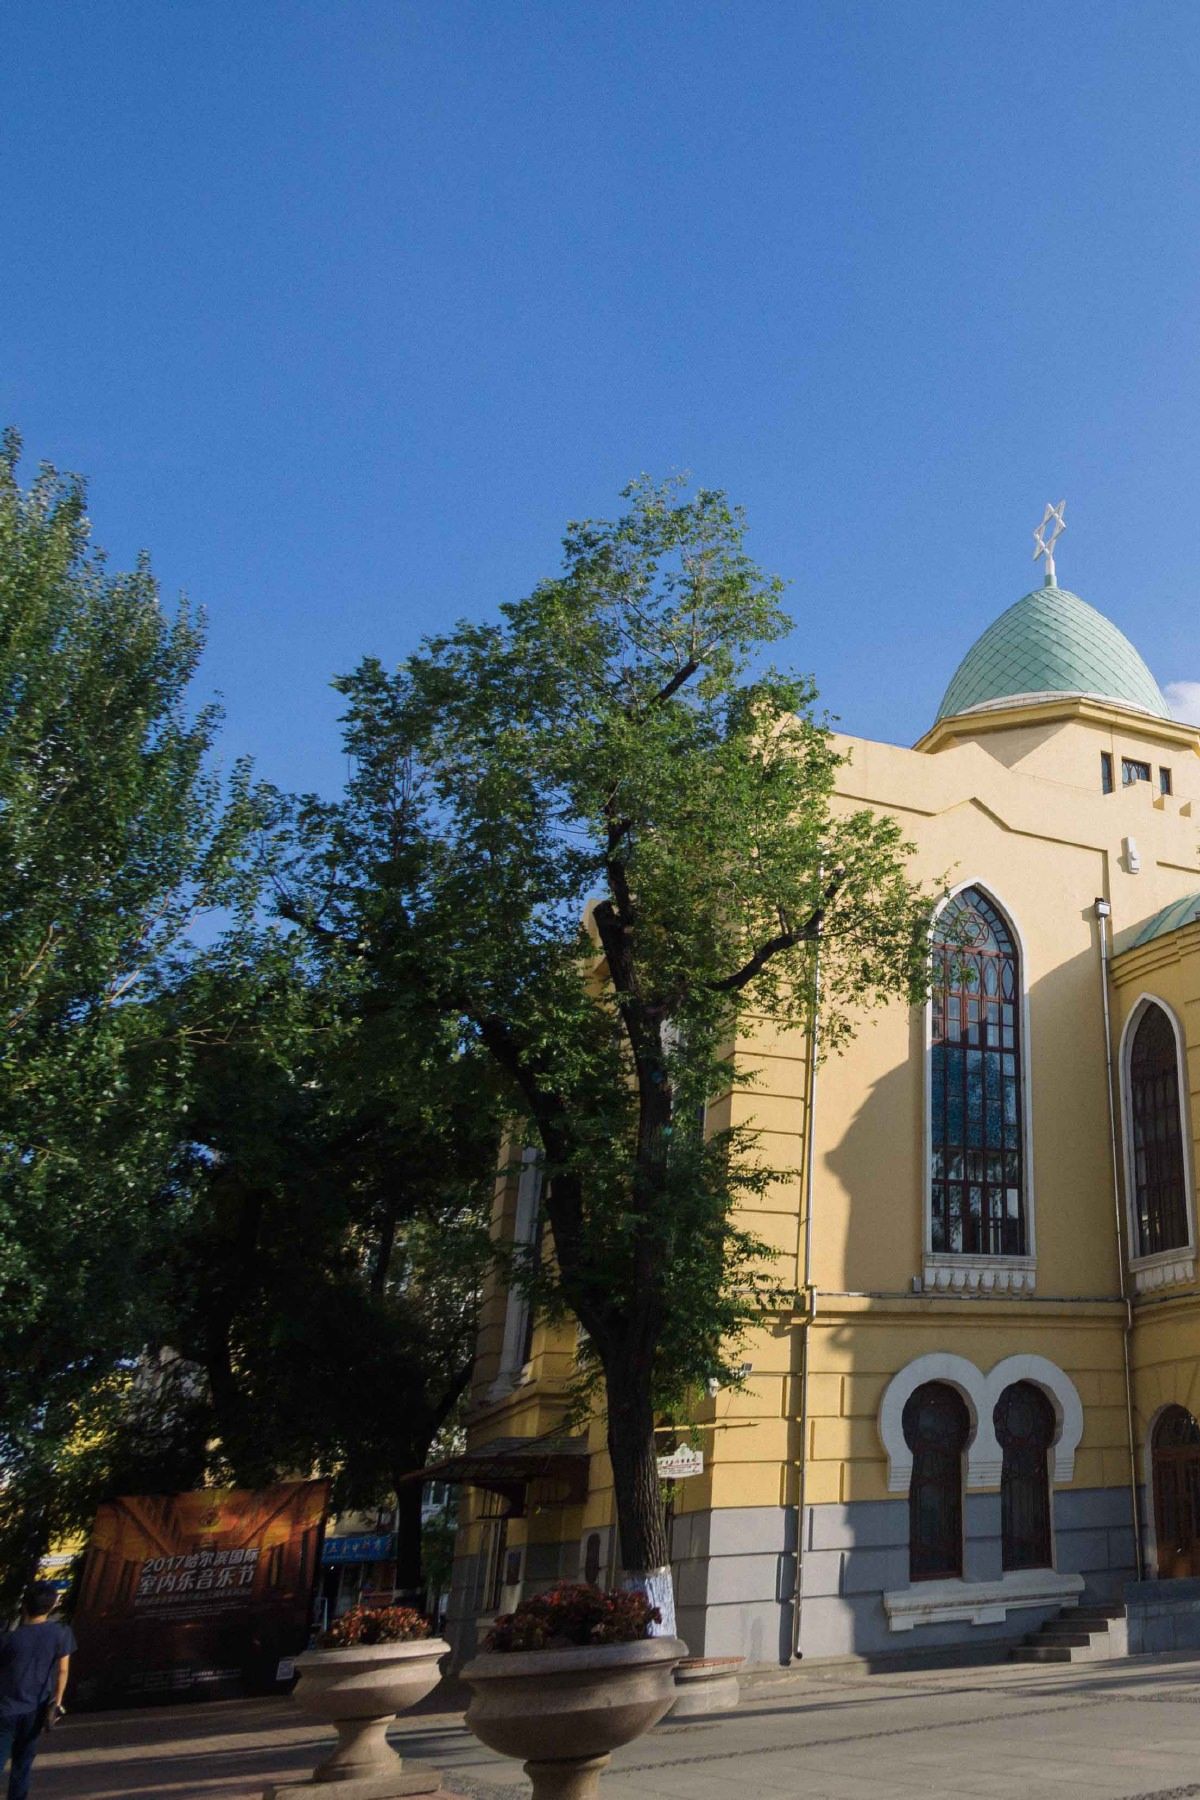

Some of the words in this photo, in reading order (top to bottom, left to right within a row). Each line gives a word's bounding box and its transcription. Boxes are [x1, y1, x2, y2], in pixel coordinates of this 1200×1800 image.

[141, 1548, 260, 1573] 2017哈尔滨国际
[136, 1566, 257, 1596] 室内乐音乐节
